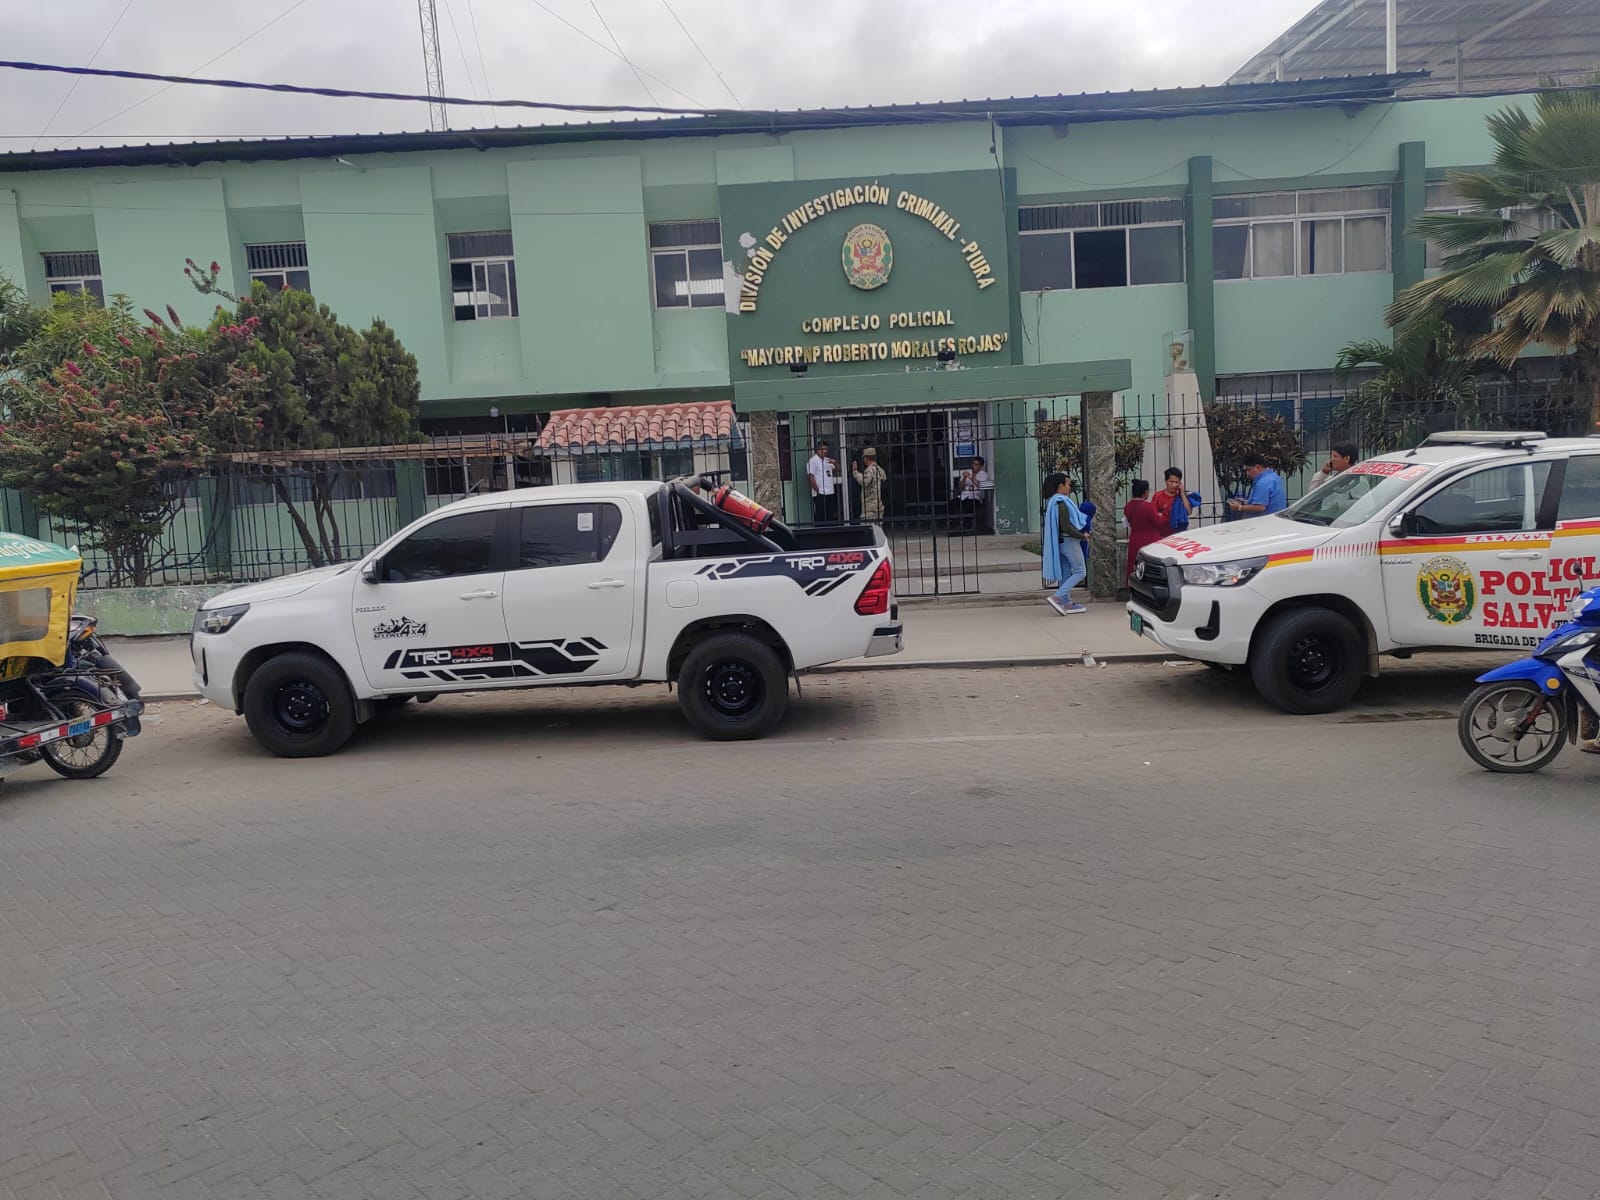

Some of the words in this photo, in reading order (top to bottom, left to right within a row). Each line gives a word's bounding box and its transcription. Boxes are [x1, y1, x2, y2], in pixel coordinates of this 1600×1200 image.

[765, 226, 788, 250] DE
[782, 179, 890, 234] INVESTIGACIÓN
[896, 190, 961, 241] CRIMINAL
[802, 315, 880, 333] COMPLEJO
[889, 310, 955, 329] POLICIAL
[823, 341, 888, 363] ROBERTO
[891, 337, 956, 358] MORALES
[785, 556, 825, 571] TRD
[825, 563, 861, 571] SPORT
[1480, 556, 1600, 596] POLICI
[1474, 633, 1519, 646] BRIGADA
[1522, 636, 1537, 647] DE
[408, 650, 452, 665] TRD
[452, 646, 494, 657] 4X4
